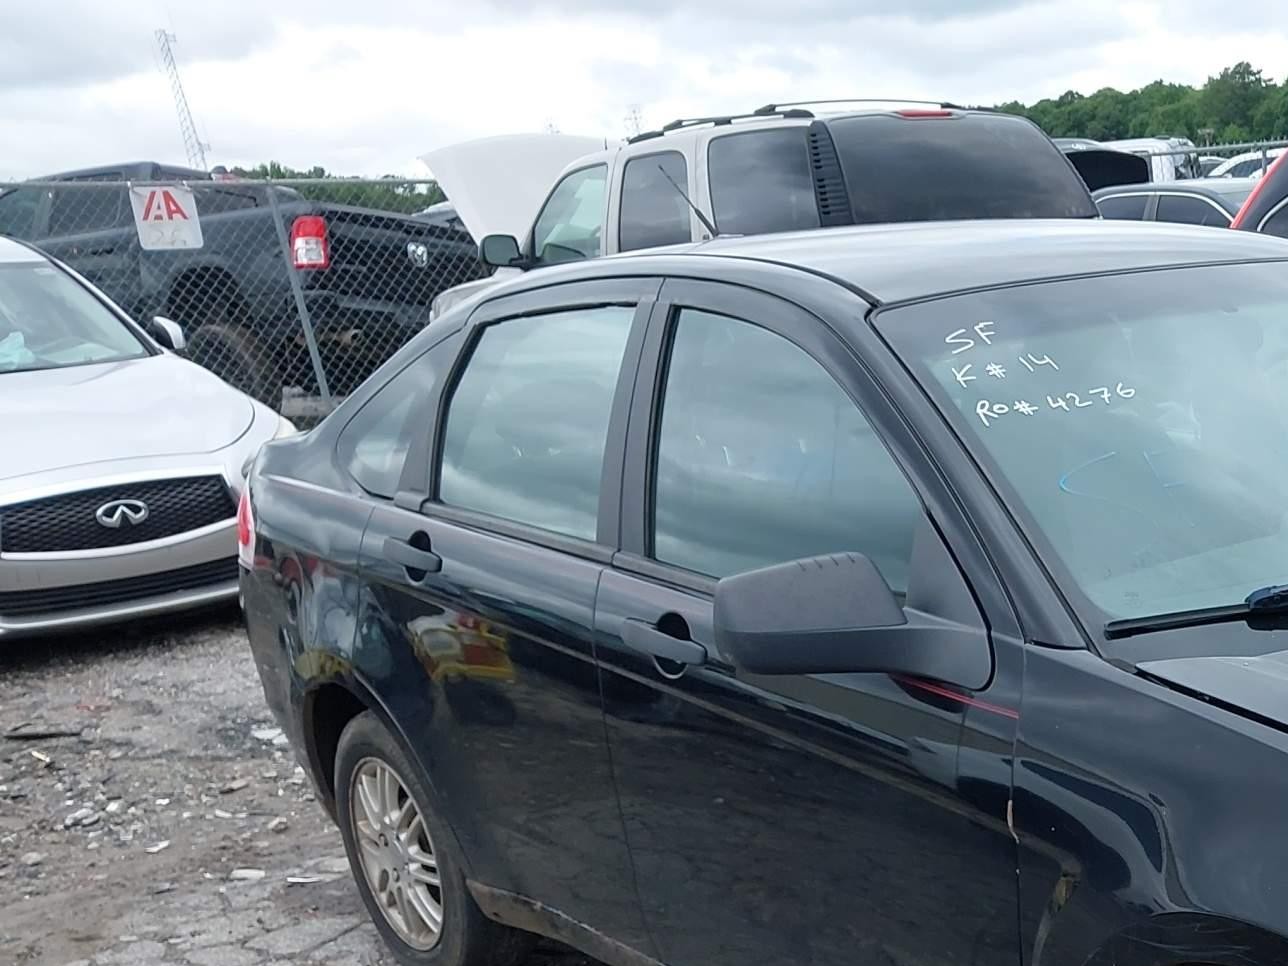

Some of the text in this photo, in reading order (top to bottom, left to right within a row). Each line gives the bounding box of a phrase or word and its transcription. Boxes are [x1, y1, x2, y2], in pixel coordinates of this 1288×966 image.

[945, 321, 995, 355] SF
[951, 353, 1060, 389] K # 14
[1046, 382, 1136, 412] 4276
